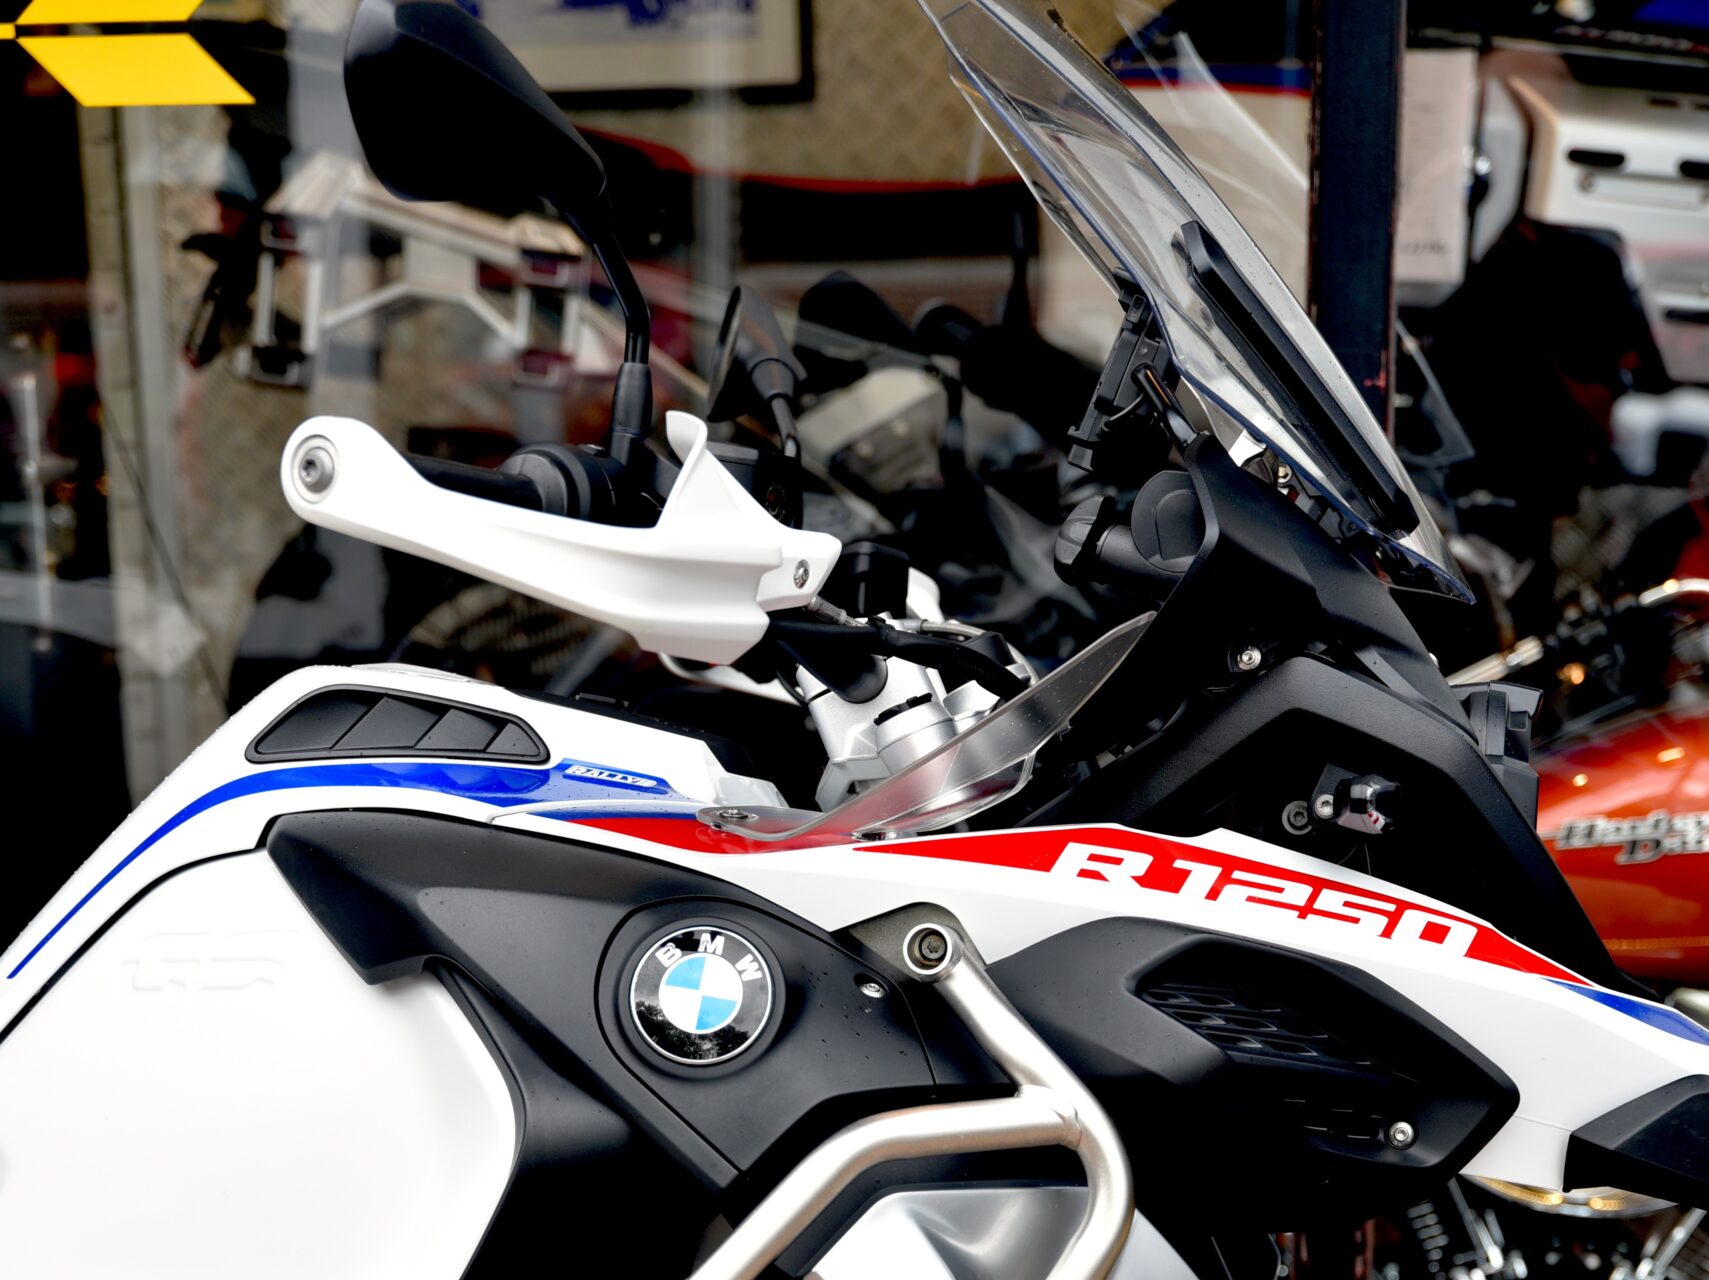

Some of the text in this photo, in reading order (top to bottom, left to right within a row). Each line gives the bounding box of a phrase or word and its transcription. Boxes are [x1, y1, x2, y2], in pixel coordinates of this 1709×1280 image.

[1048, 841, 1479, 958] R 1250
[654, 932, 763, 982] BMW
